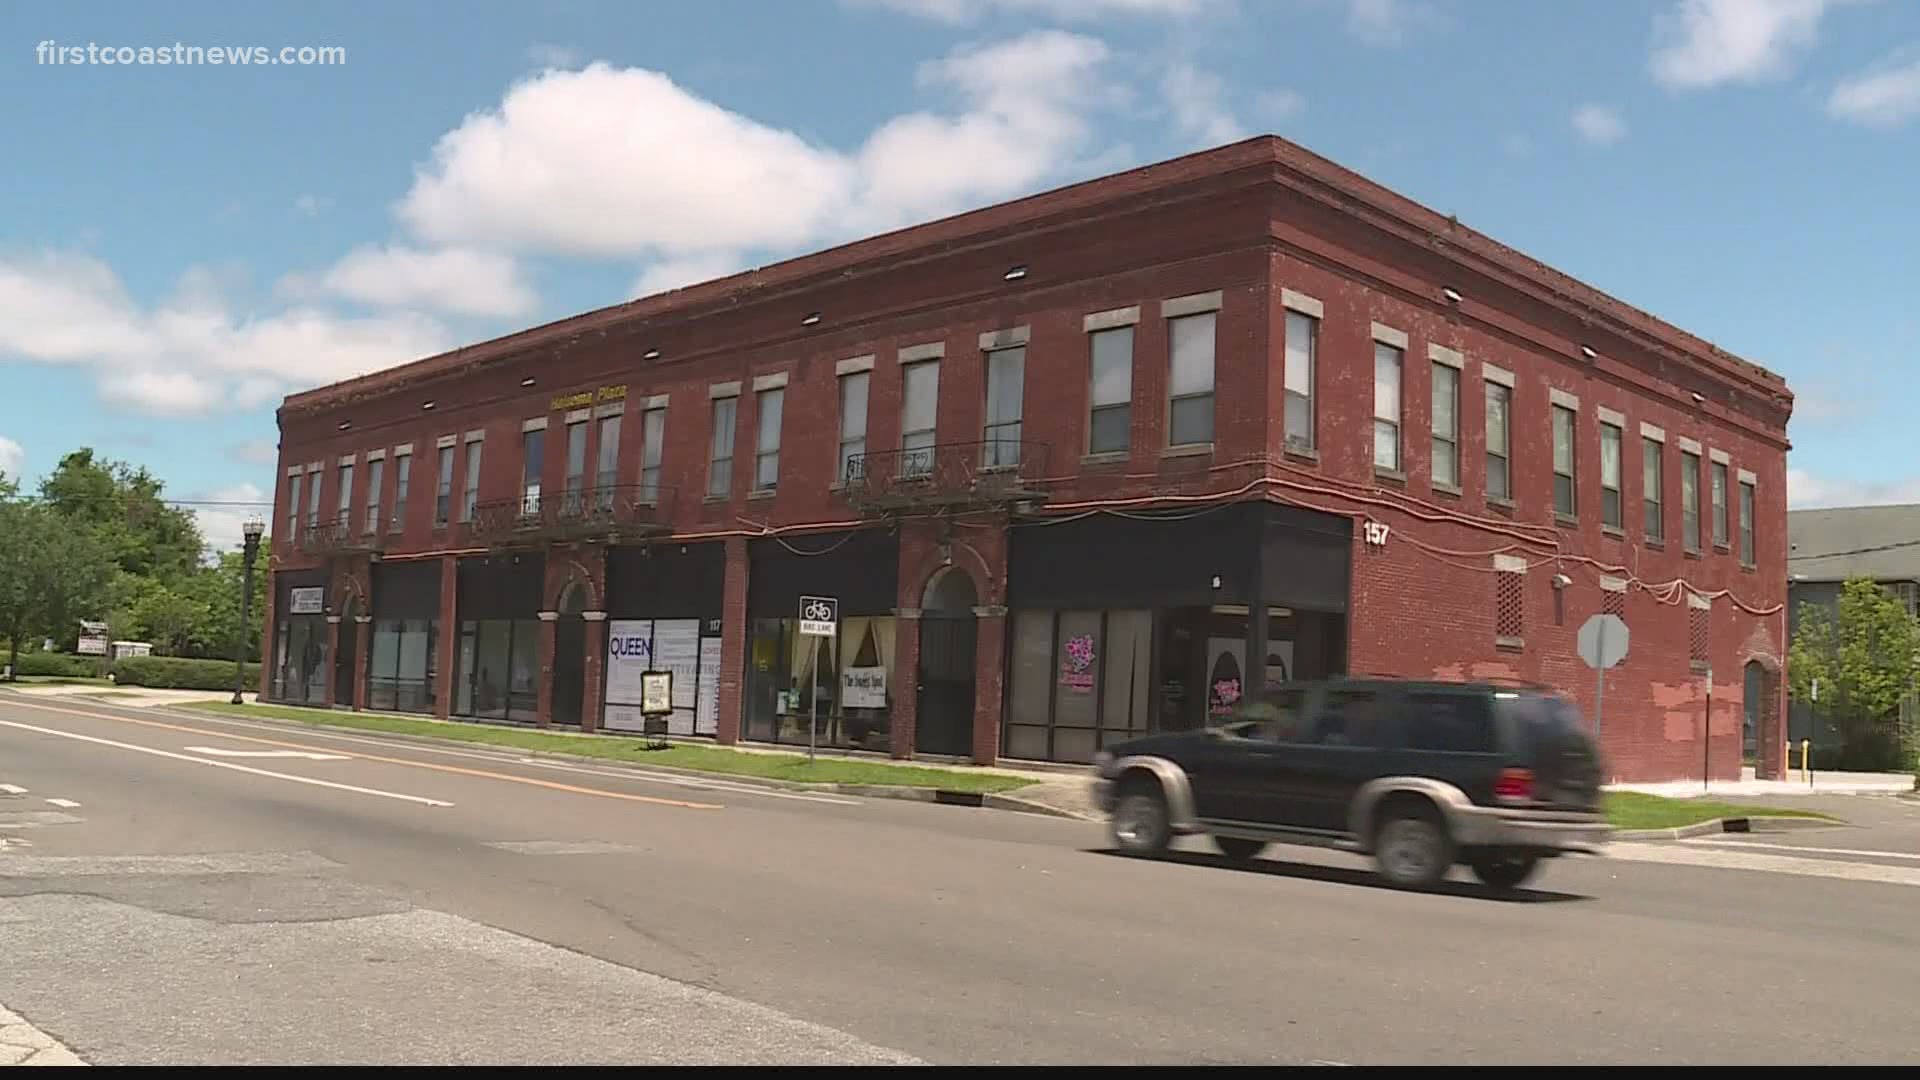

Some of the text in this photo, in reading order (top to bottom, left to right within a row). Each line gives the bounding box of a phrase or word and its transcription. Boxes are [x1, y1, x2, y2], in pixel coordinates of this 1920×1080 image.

[1363, 520, 1390, 545] 157
[817, 624, 833, 633] LANE
[610, 637, 652, 660] QUEEN
